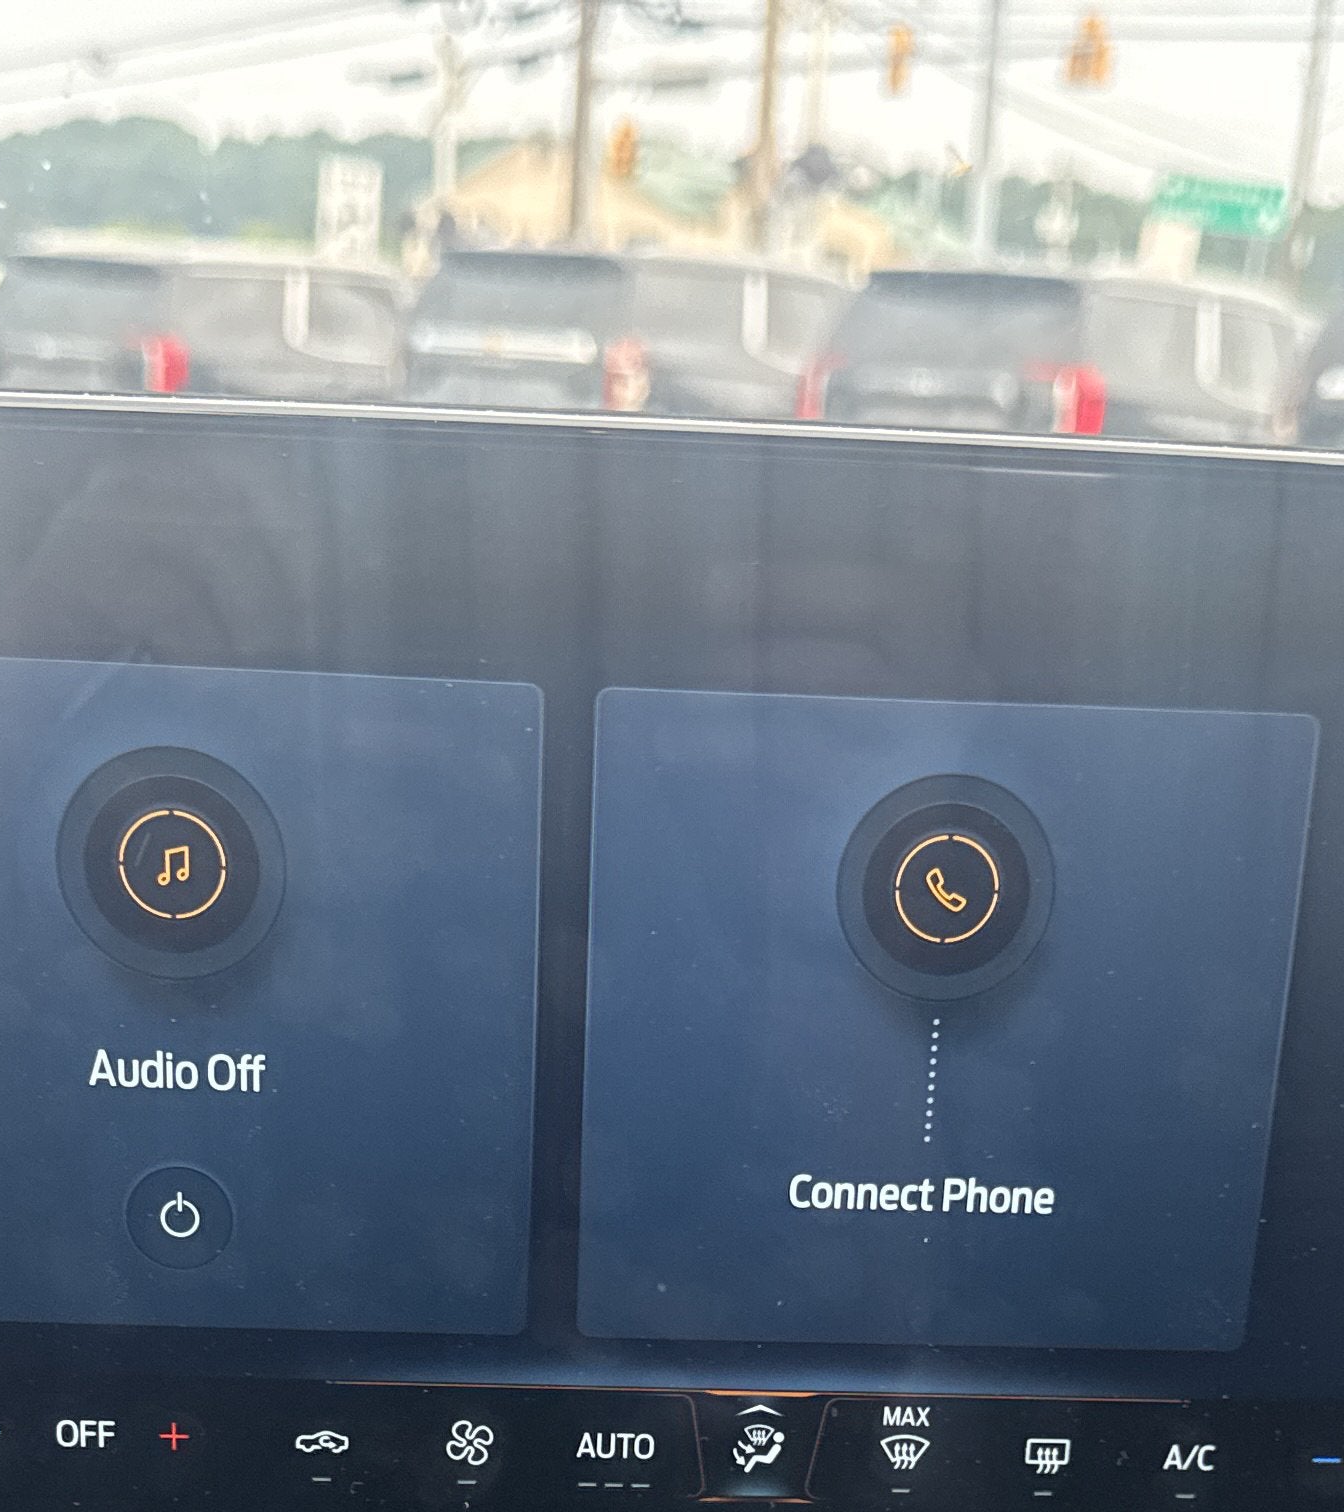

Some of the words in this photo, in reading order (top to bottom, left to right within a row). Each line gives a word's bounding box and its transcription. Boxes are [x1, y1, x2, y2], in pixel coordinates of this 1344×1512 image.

[88, 1048, 199, 1090] Audio
[207, 1053, 267, 1093] Off
[788, 1173, 935, 1212] Connect
[941, 1176, 1055, 1215] Phone
[882, 1406, 932, 1427] MAX
[55, 1419, 117, 1450] OFF
[575, 1431, 656, 1461] AUTO
[1162, 1443, 1217, 1473] A/C
